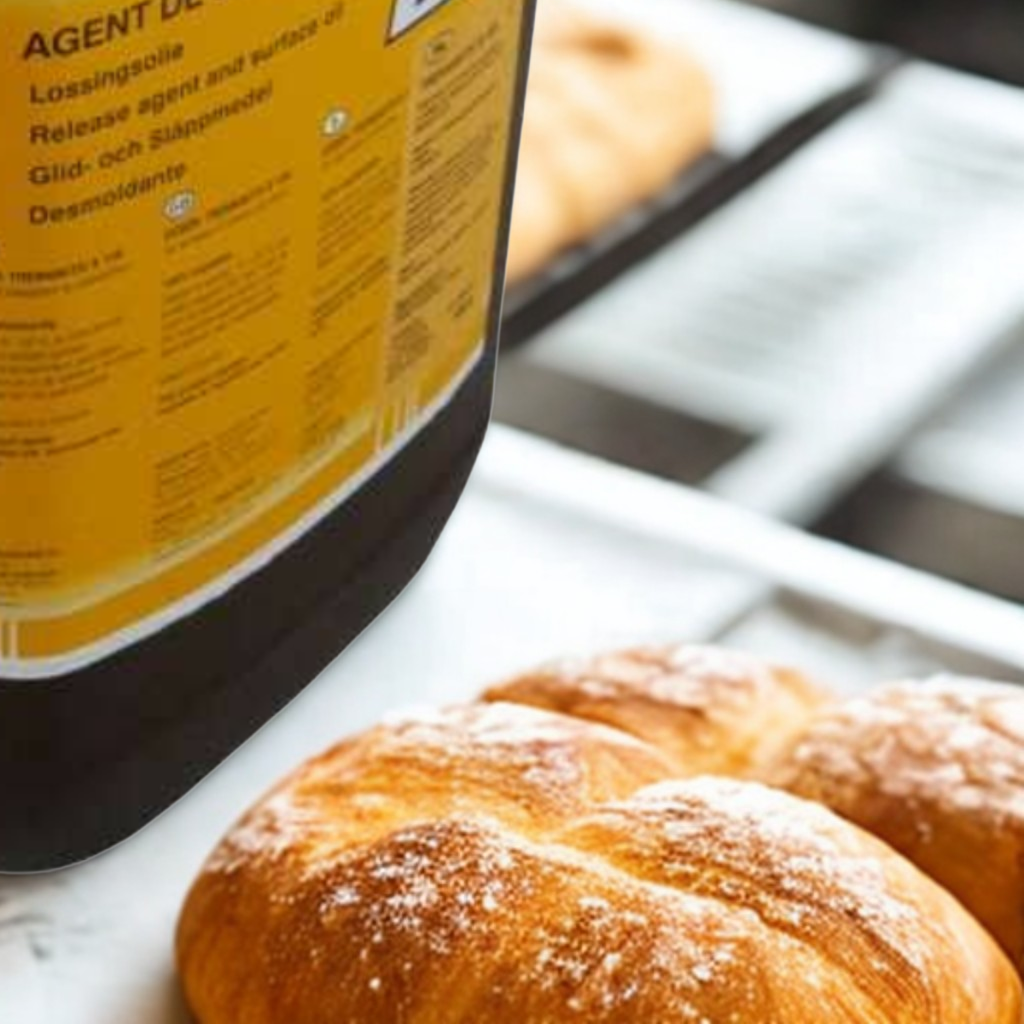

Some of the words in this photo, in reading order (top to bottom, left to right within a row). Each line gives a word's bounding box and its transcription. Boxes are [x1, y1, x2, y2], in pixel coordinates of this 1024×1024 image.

[22, 0, 153, 60] AGENT
[29, 106, 130, 145] Release
[137, 73, 200, 118] agent
[29, 163, 187, 225] Desmoldante
